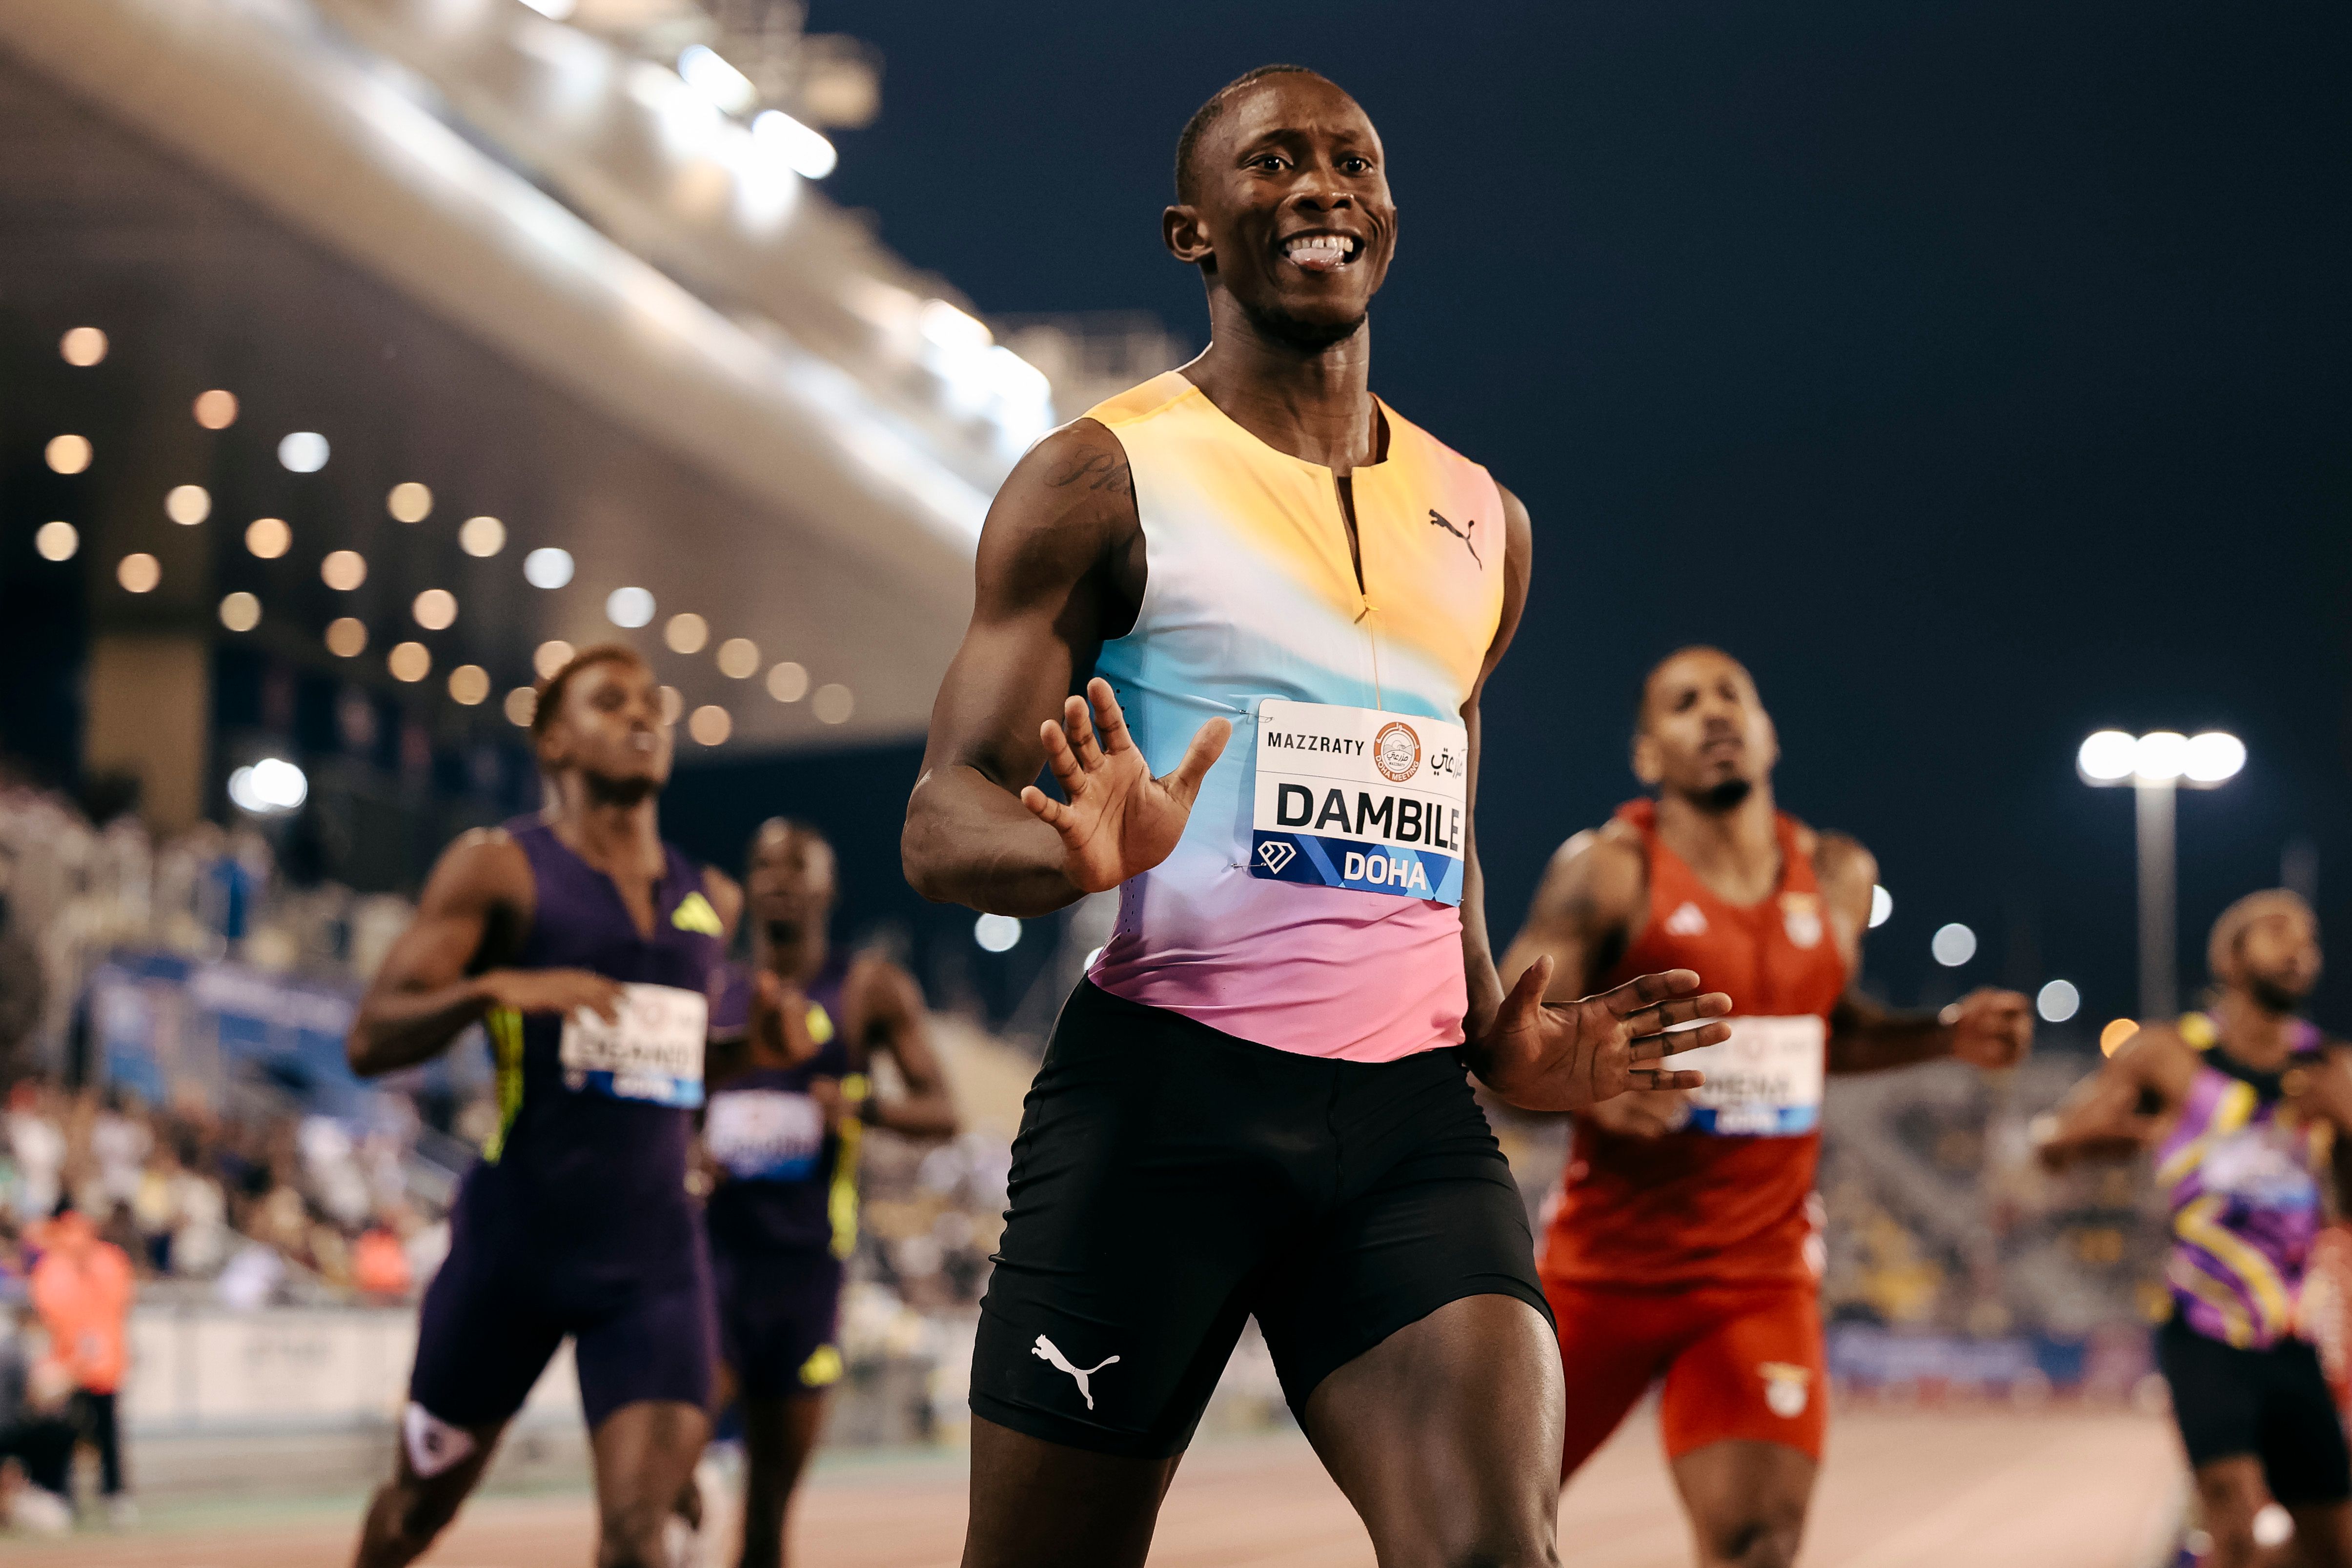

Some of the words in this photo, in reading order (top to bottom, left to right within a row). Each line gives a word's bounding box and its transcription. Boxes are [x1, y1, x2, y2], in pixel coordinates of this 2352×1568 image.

[1268, 732, 1364, 756] MAZZRATY
[1376, 755, 1391, 778] DOHA
[1392, 761, 1419, 781] MEETING
[1277, 783, 1459, 852] DAMBILE
[1344, 852, 1426, 890] DOHA
